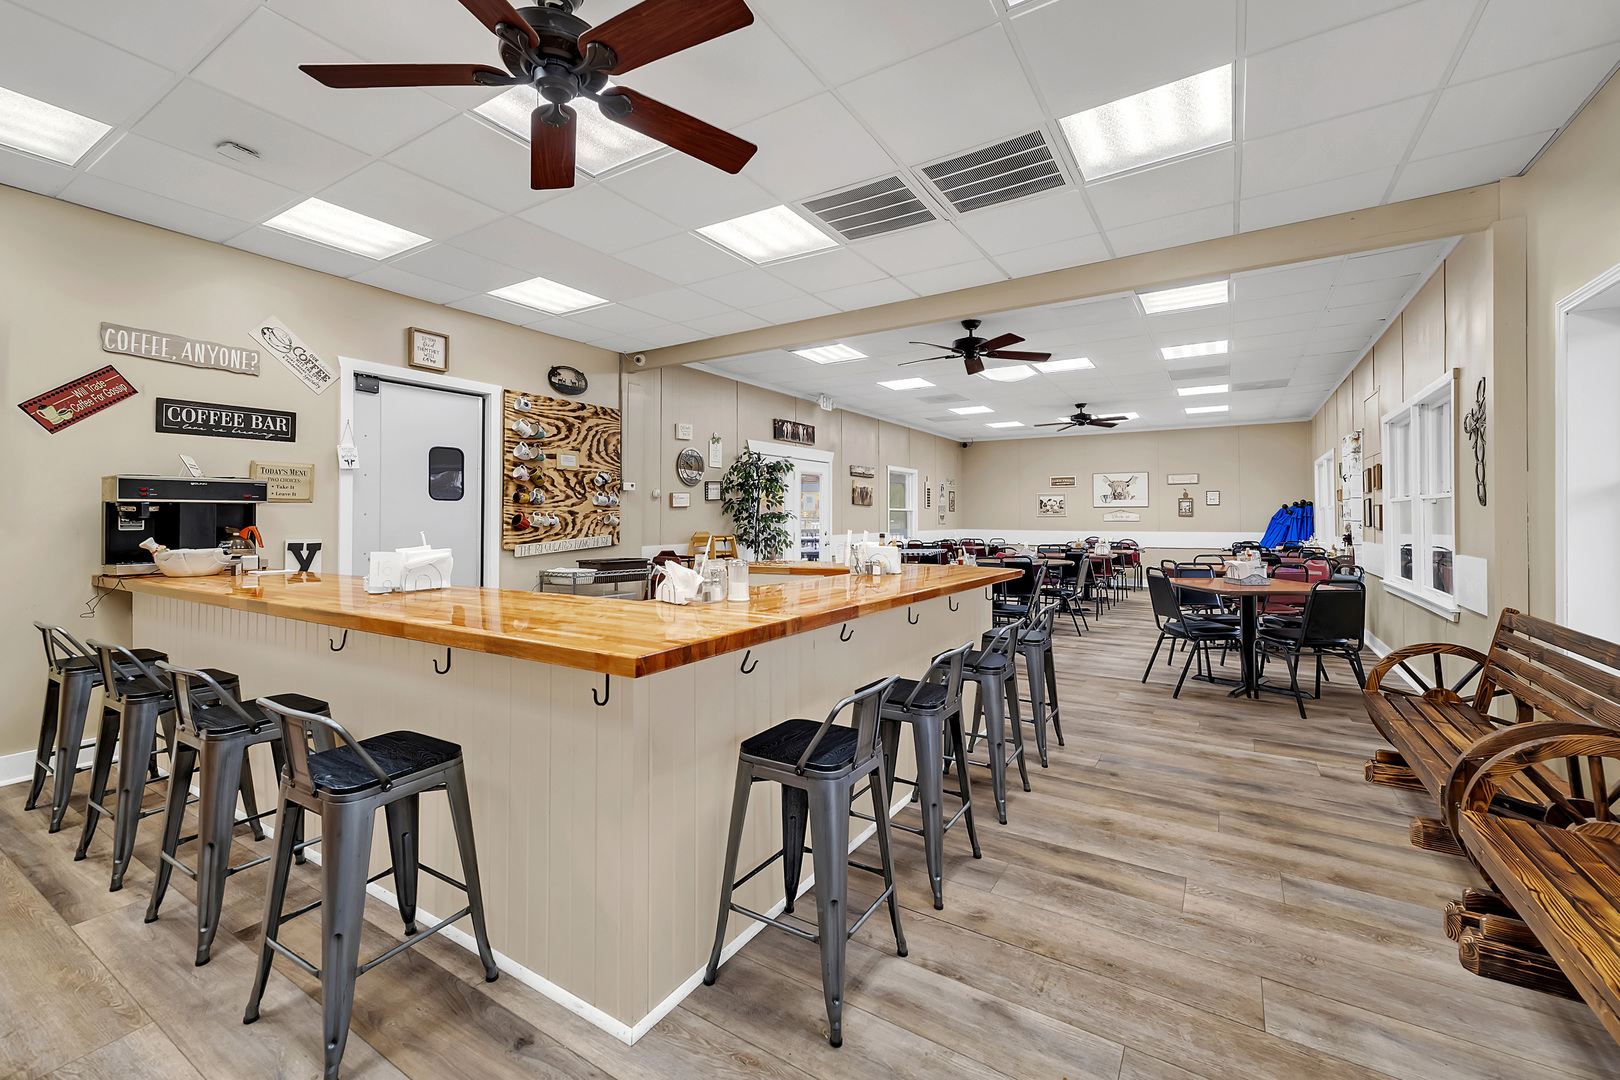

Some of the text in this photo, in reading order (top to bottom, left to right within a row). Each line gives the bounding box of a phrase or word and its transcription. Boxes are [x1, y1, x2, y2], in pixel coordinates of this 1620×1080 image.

[104, 328, 177, 361] COFFEE,
[181, 342, 258, 371] ANYONE?
[70, 383, 128, 412] Coffee For Gossip
[71, 380, 107, 399] Will Trade
[167, 406, 288, 432] COFFEE BAR
[260, 466, 289, 475] TODAY'S
[287, 543, 322, 572] Y
[518, 545, 532, 556] THE
[534, 540, 573, 554] REGULARS
